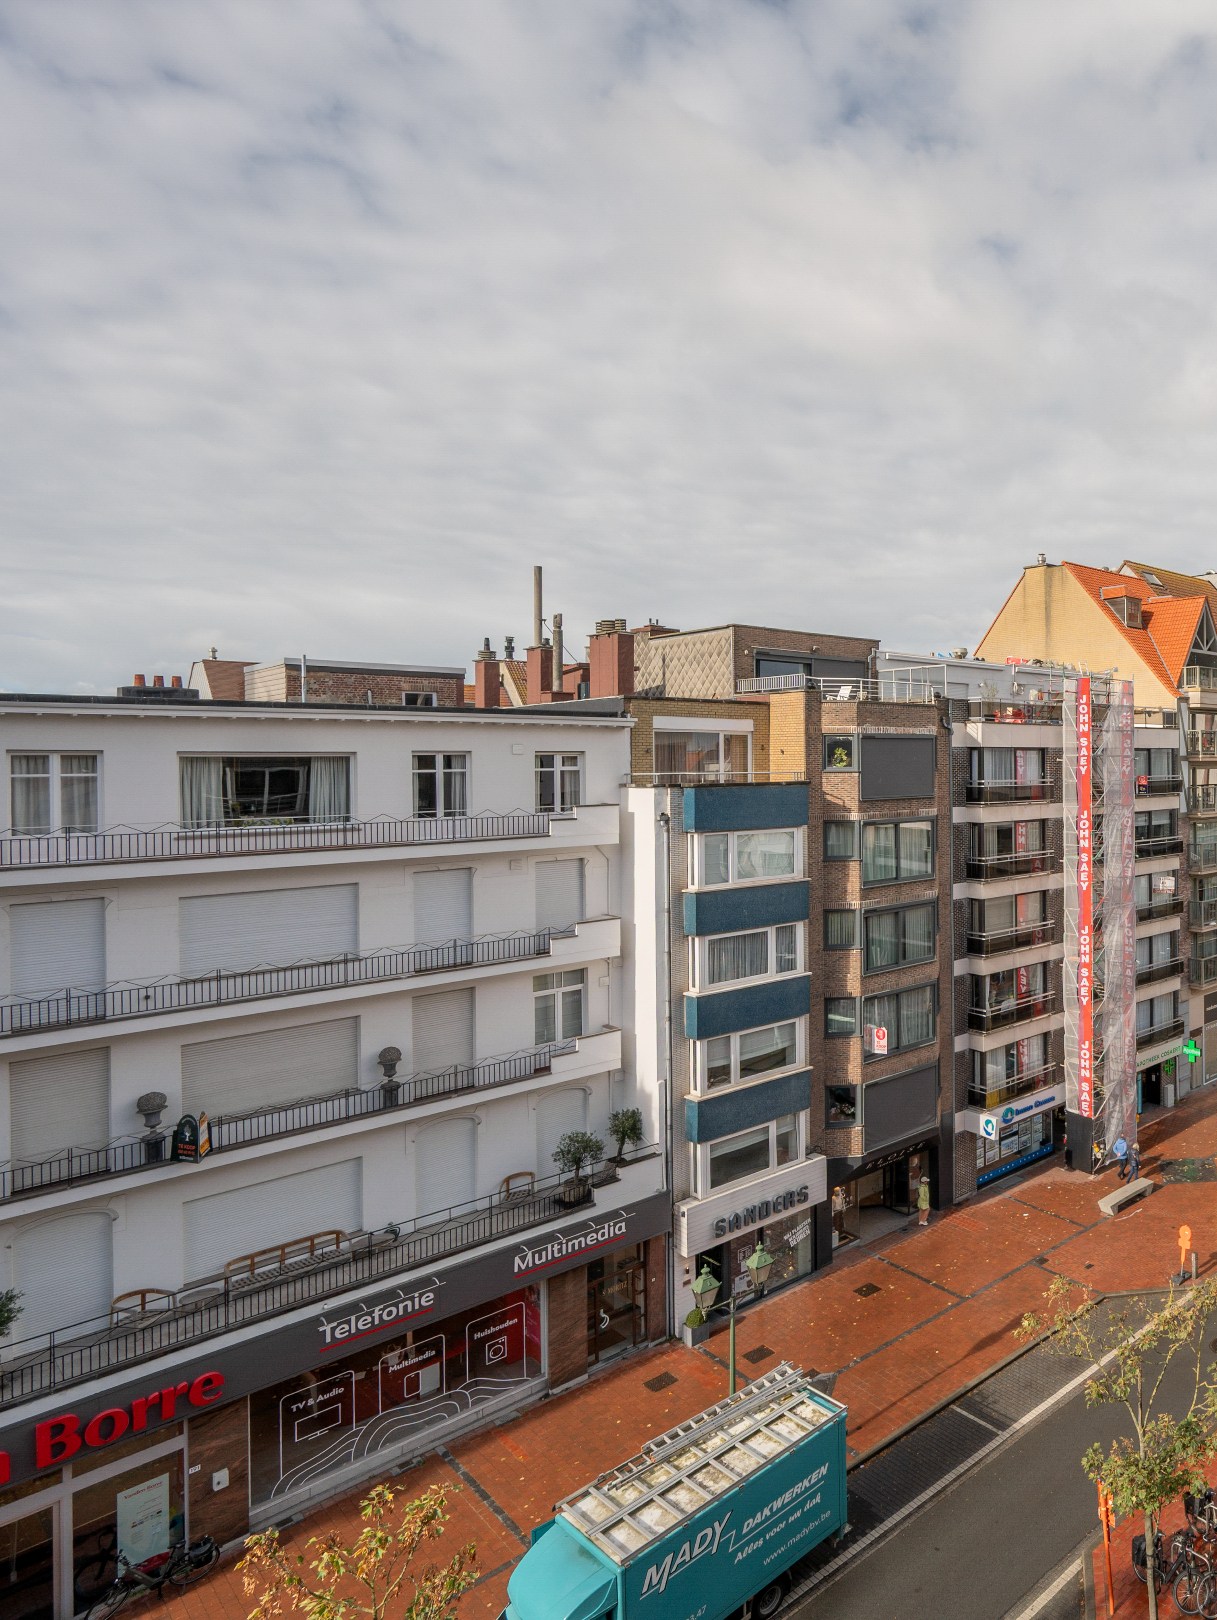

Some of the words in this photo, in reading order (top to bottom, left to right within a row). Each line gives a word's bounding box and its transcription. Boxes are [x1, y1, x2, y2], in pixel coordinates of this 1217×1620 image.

[1079, 694, 1089, 732] JOHN
[1079, 737, 1089, 775] SAEY
[1079, 810, 1089, 848] JOHN
[1079, 853, 1089, 891] SAEY
[1080, 925, 1090, 963] JOHN
[1080, 968, 1090, 1006] SAEY
[1080, 1041, 1090, 1078] JOHN
[1080, 1082, 1091, 1118] SAEY
[713, 1185, 809, 1239] SANDERS
[513, 1221, 627, 1273] Multimedia
[318, 1290, 435, 1344] Telefonie
[474, 1318, 518, 1341] Huishouden
[388, 1350, 436, 1374] Multimedia
[291, 1402, 306, 1413] TV
[315, 1386, 345, 1404] Audio
[35, 1371, 225, 1470] Borre
[641, 1509, 734, 1595] MADY
[742, 1462, 829, 1535] DAKWERKEN
[734, 1538, 764, 1565] Alles
[766, 1520, 787, 1541] voor
[803, 1492, 821, 1513] dak
[763, 1510, 831, 1566] www.madybv.be
